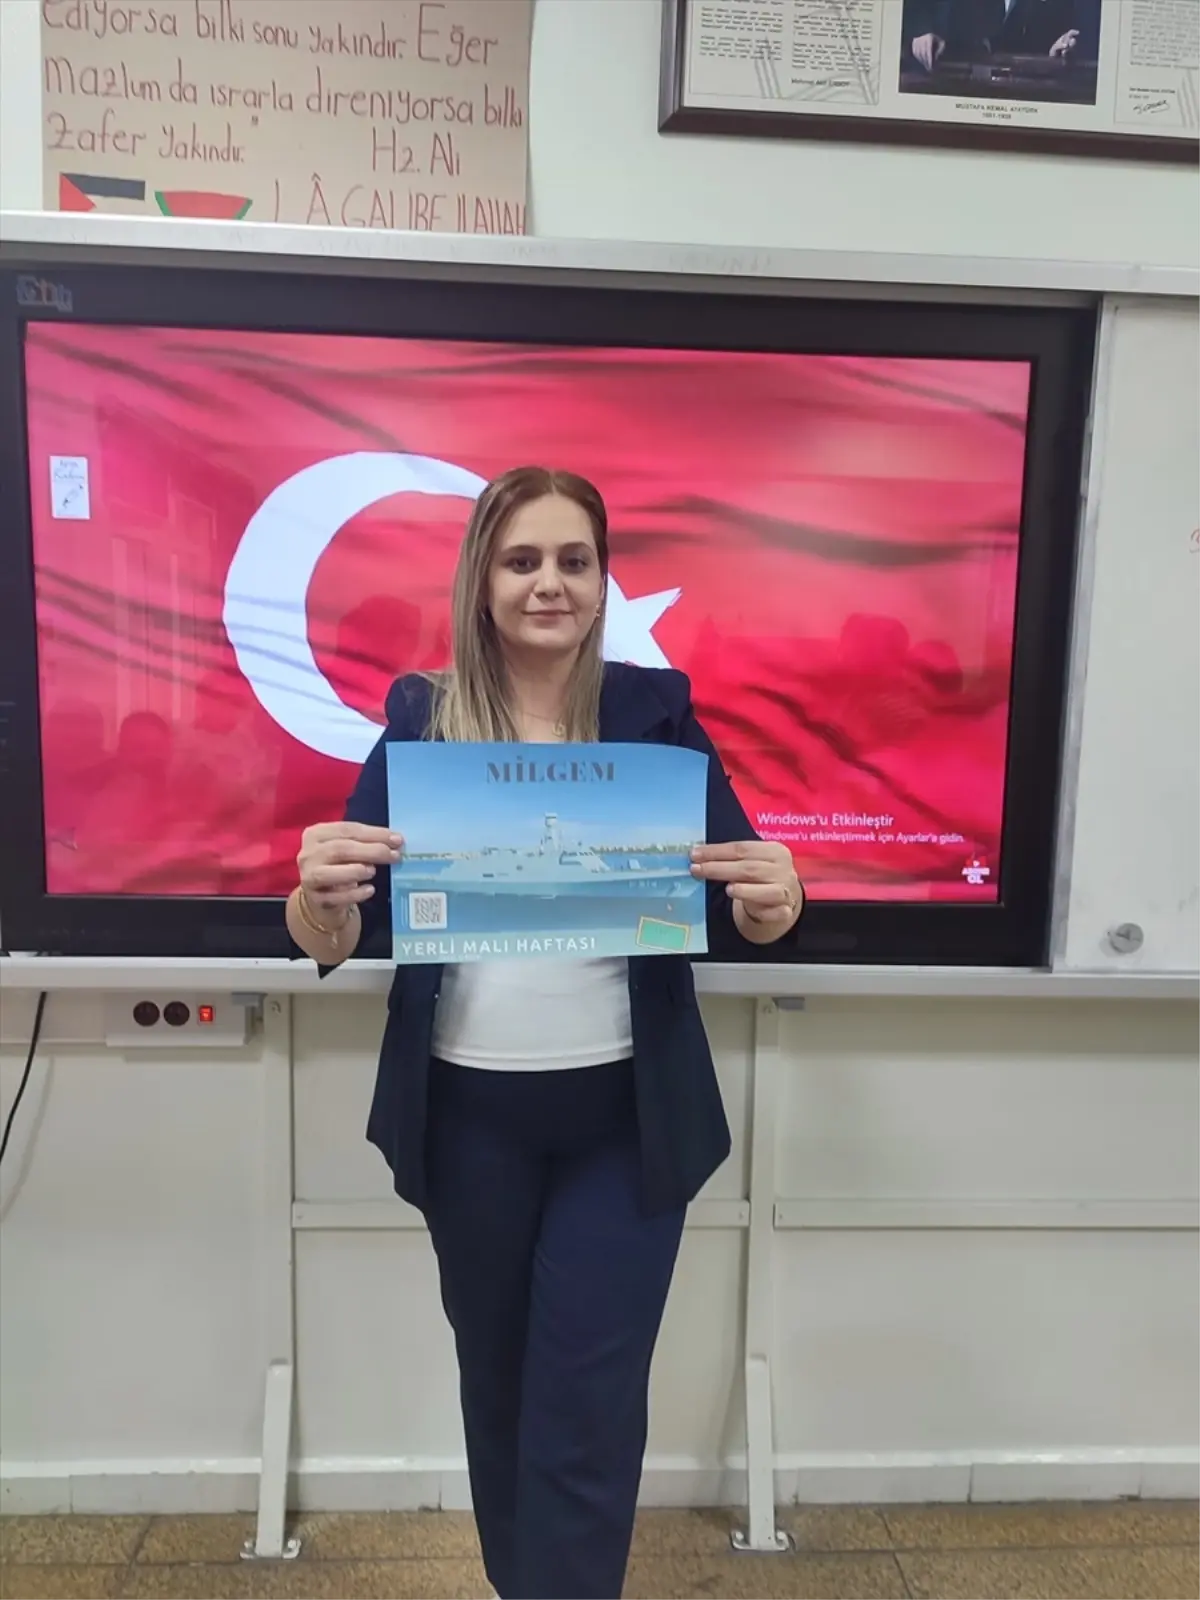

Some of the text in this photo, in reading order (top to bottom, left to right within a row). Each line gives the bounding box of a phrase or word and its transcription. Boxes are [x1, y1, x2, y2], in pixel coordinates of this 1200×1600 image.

[252, 20, 299, 48] sonu
[417, 2, 499, 66] Eğer
[486, 754, 615, 783] MİLGEM
[756, 811, 895, 830] Windows'u Etkinleştir
[401, 936, 596, 957] YERLİ MALI HAFTASI
